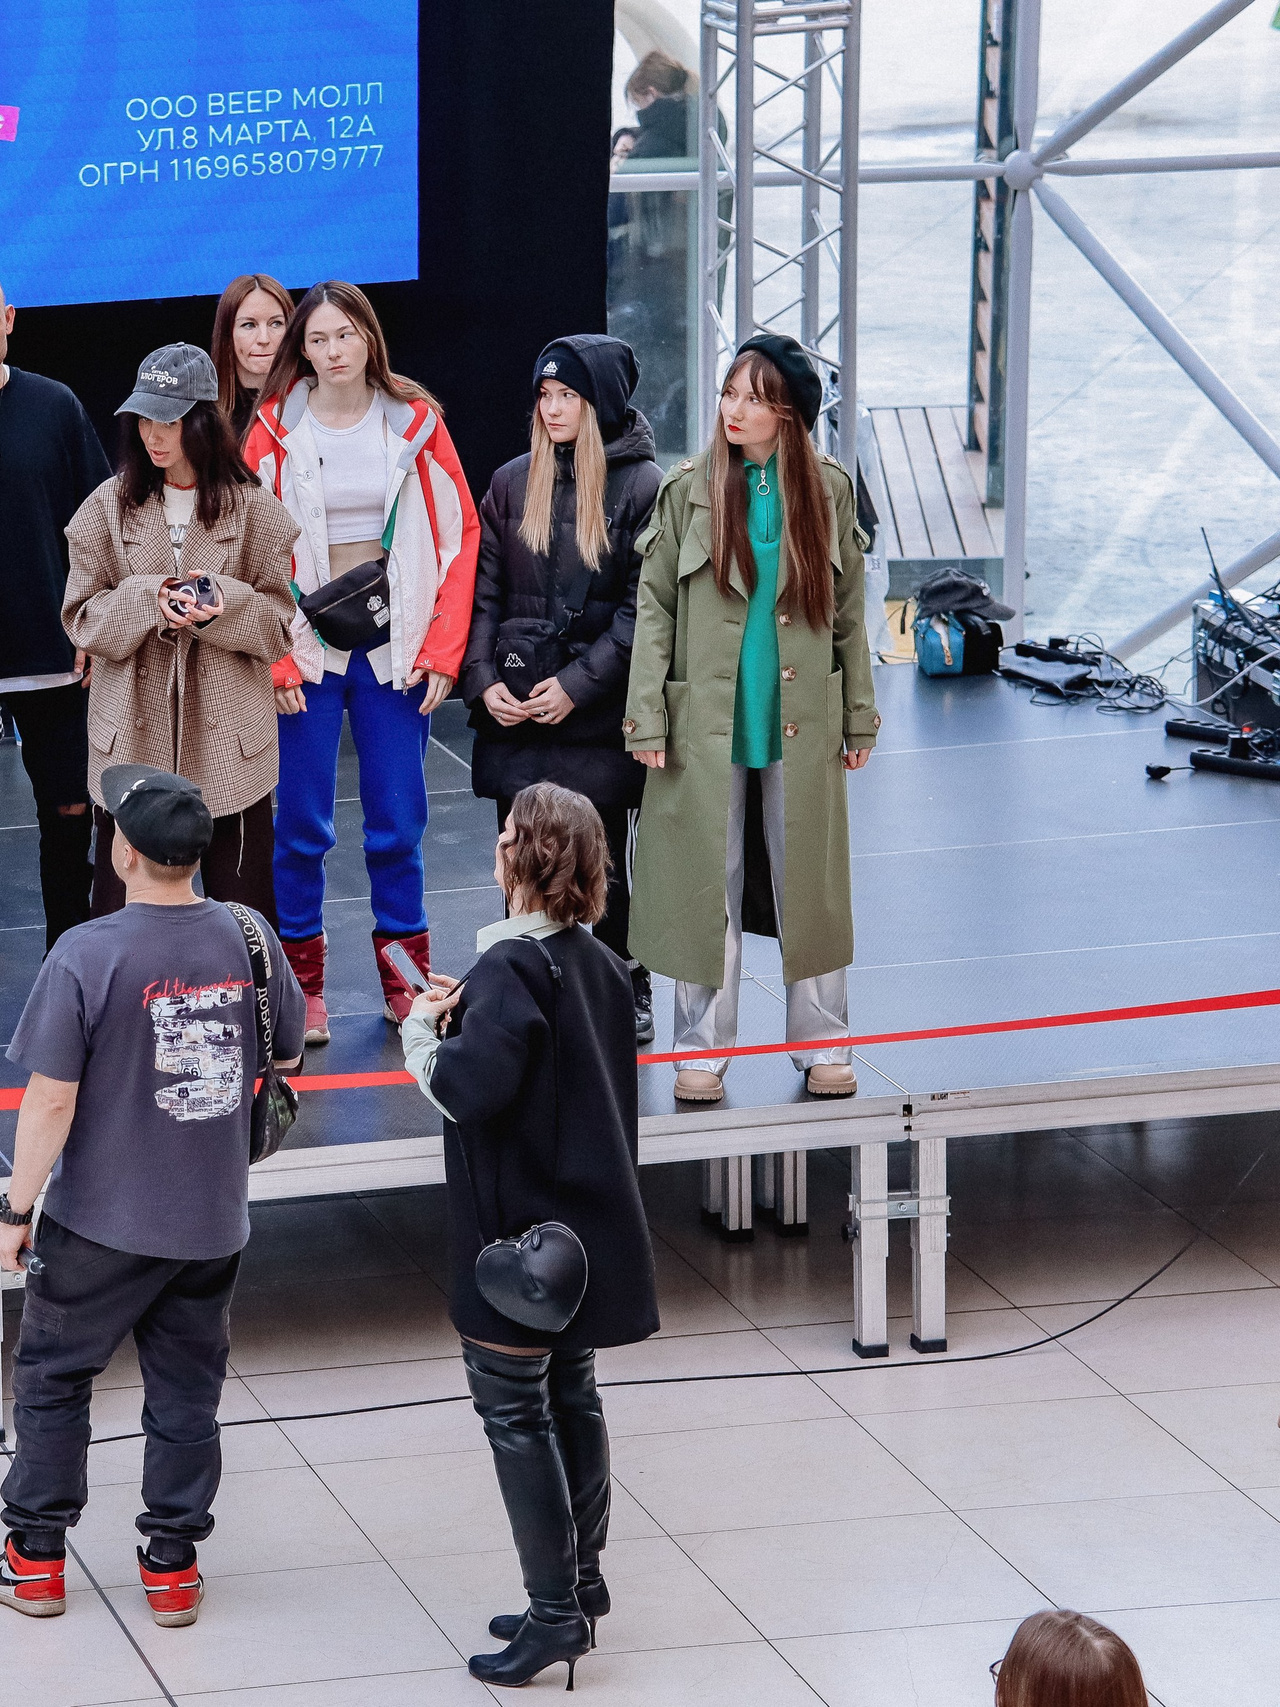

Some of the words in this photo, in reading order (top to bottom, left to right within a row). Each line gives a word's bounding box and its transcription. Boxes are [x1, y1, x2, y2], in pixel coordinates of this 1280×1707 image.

[125, 94, 198, 121] ООО
[207, 88, 283, 116] ВЕЕР
[292, 82, 383, 110] МОЛЛ
[136, 125, 199, 152] УЛ.8
[208, 119, 317, 148] МАРТА,
[327, 114, 377, 139] 12А
[78, 160, 159, 187] ОГРН
[169, 144, 384, 181] 1169658079777
[226, 902, 262, 956] ОБРОТА
